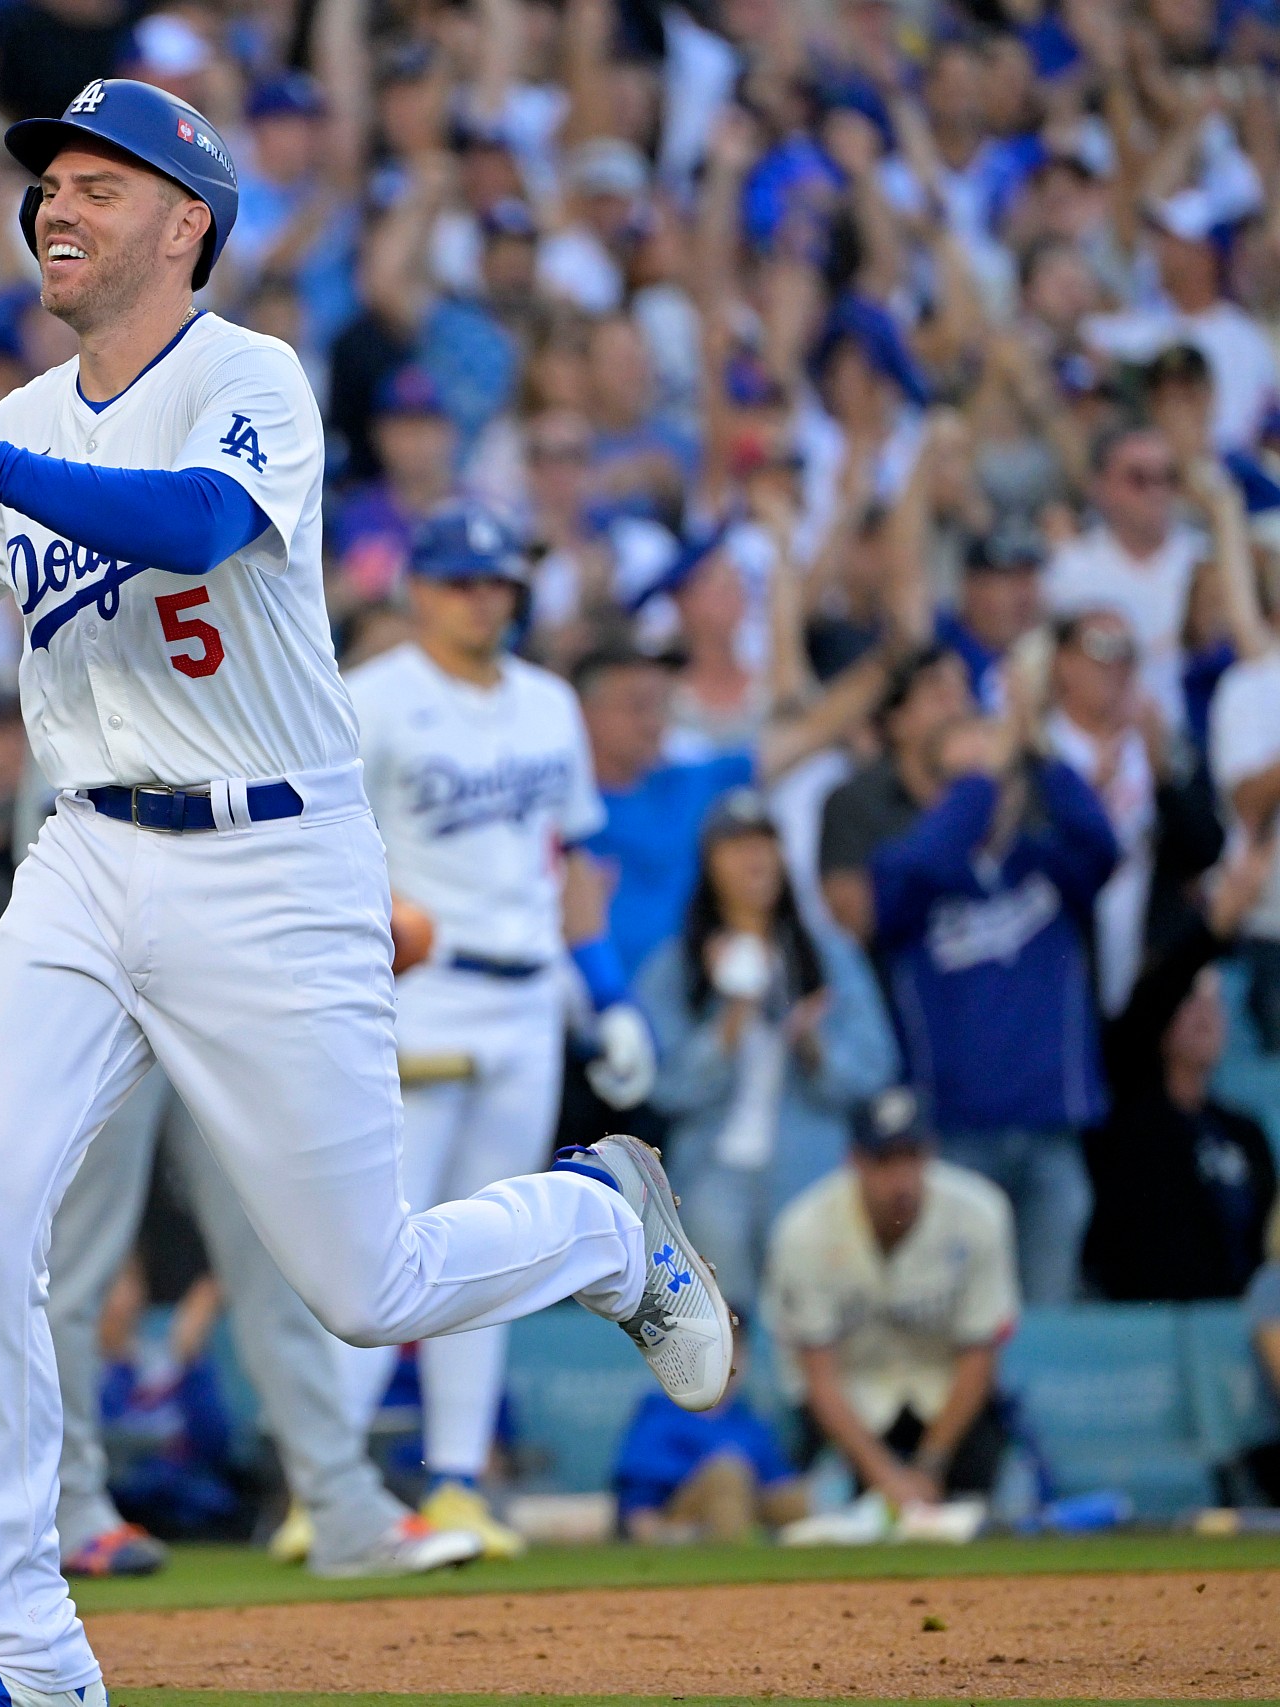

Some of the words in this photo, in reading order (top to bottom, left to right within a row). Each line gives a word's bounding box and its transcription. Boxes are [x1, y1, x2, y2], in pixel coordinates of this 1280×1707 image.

[70, 78, 106, 114] LA
[219, 412, 268, 474] LA
[154, 584, 225, 678] 5
